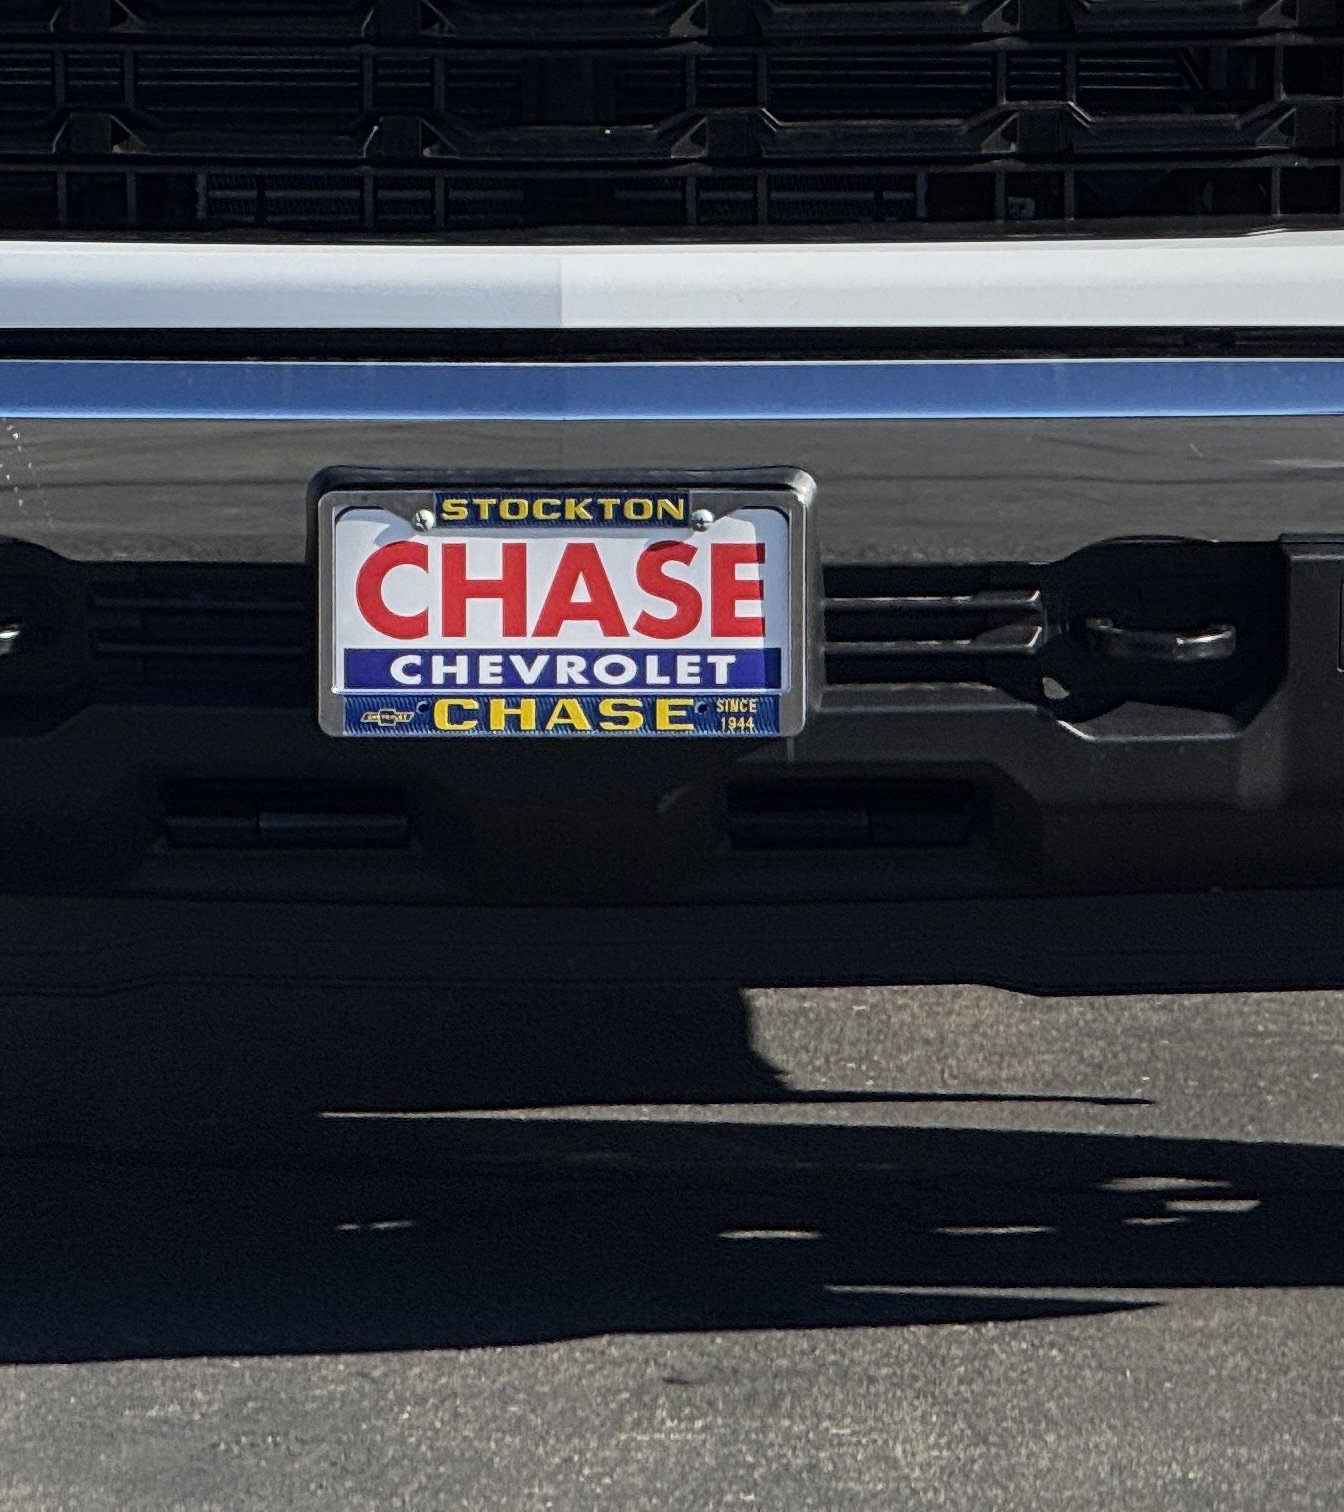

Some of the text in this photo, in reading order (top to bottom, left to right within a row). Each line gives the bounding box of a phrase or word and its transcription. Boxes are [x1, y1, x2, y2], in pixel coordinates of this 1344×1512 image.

[440, 497, 686, 522] STOCKTON
[355, 540, 766, 640] CHASE
[389, 653, 736, 686] CHEVROLET
[433, 697, 696, 732] CHASE
[716, 698, 758, 713] SINCE
[721, 716, 755, 733] 1944
